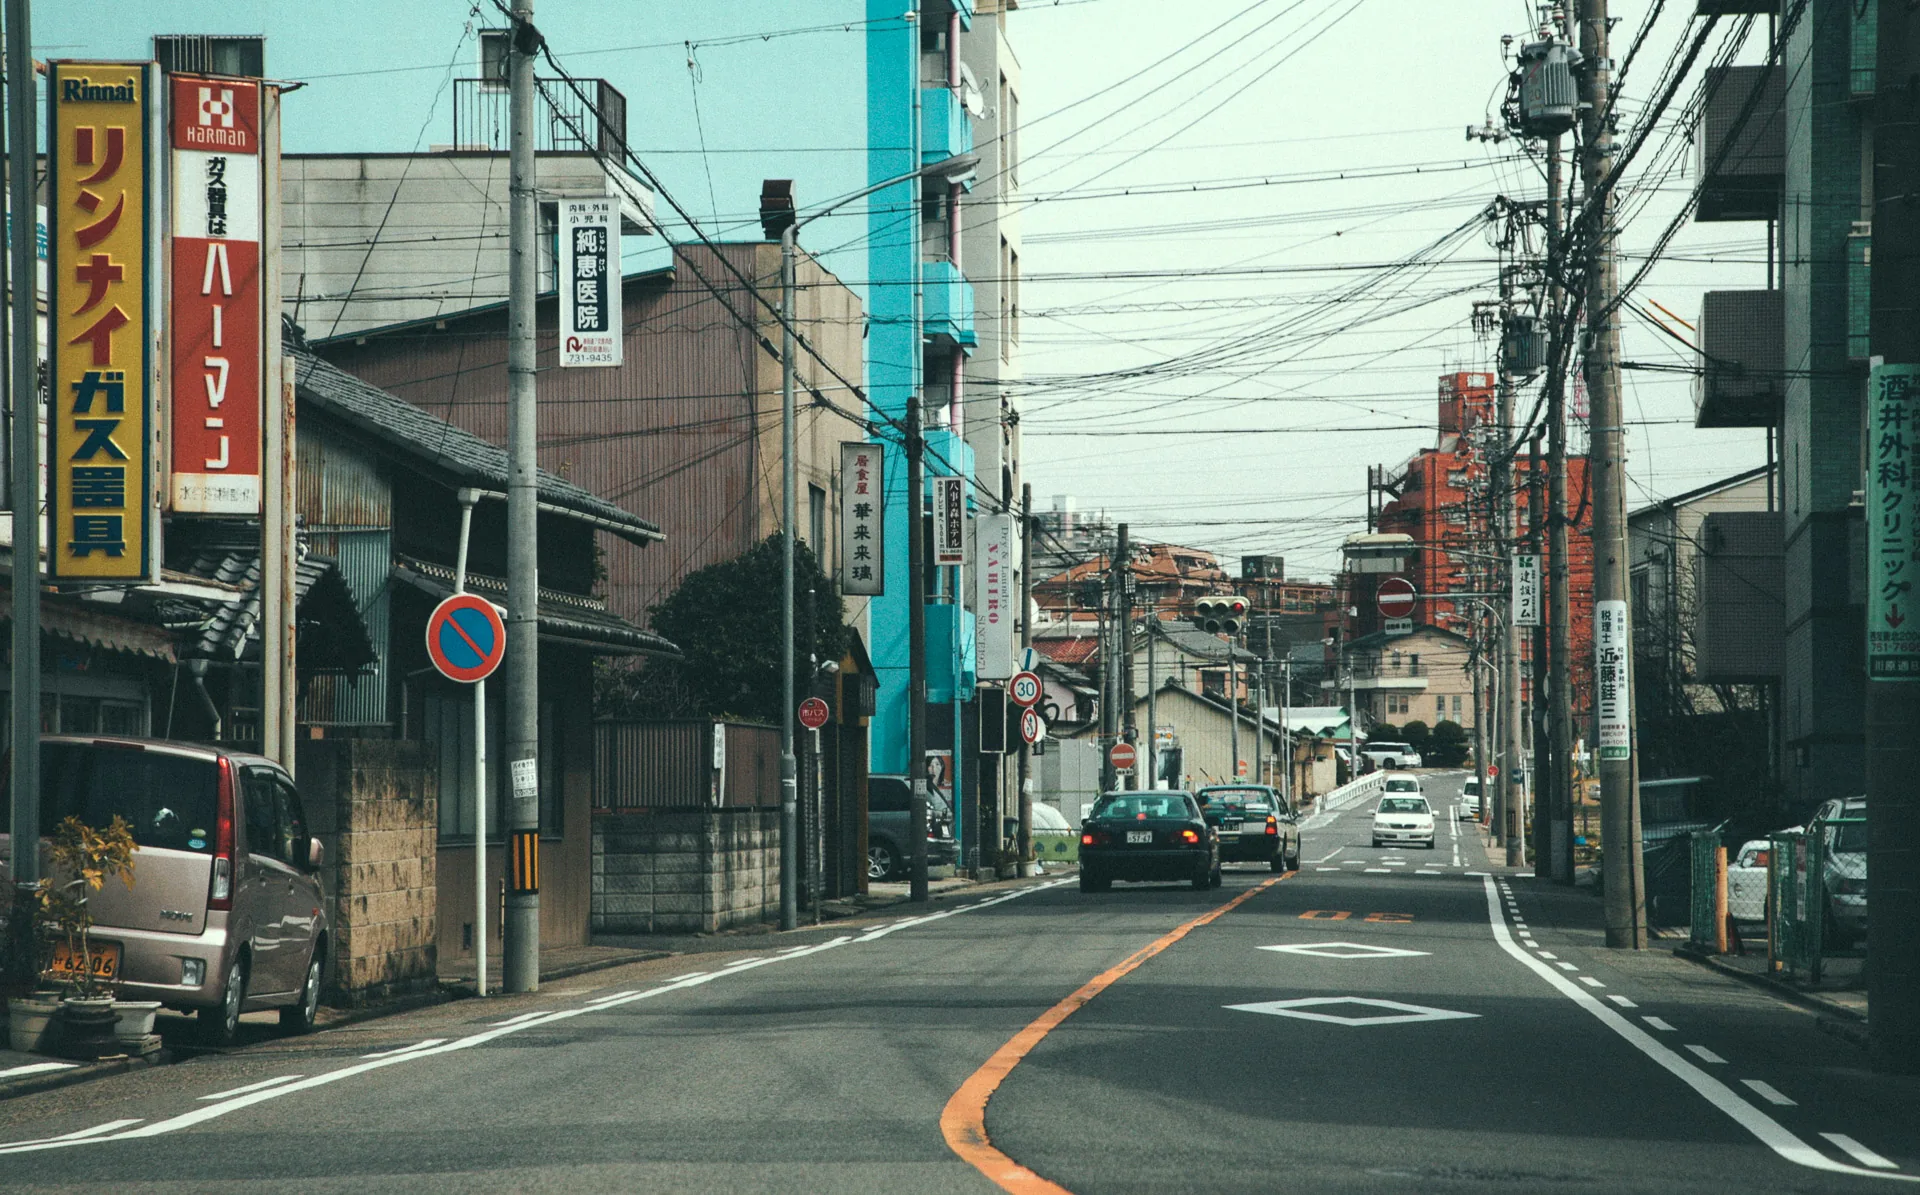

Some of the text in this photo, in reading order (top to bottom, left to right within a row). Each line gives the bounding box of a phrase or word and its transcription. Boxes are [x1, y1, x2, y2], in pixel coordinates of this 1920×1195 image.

[61, 77, 136, 103] Rinnai
[206, 157, 228, 235] ガス器具は
[576, 229, 599, 329] 純恵医院
[202, 243, 233, 470] ハーマン
[569, 353, 613, 362] 731-9435
[854, 454, 869, 495] 居食屋
[1877, 374, 1910, 603] 酒井外科クリニック
[999, 526, 1009, 609] Dry & Laundry
[1601, 609, 1612, 644] 税理士
[1017, 682, 1035, 696] 30
[802, 709, 825, 717] 市バス
